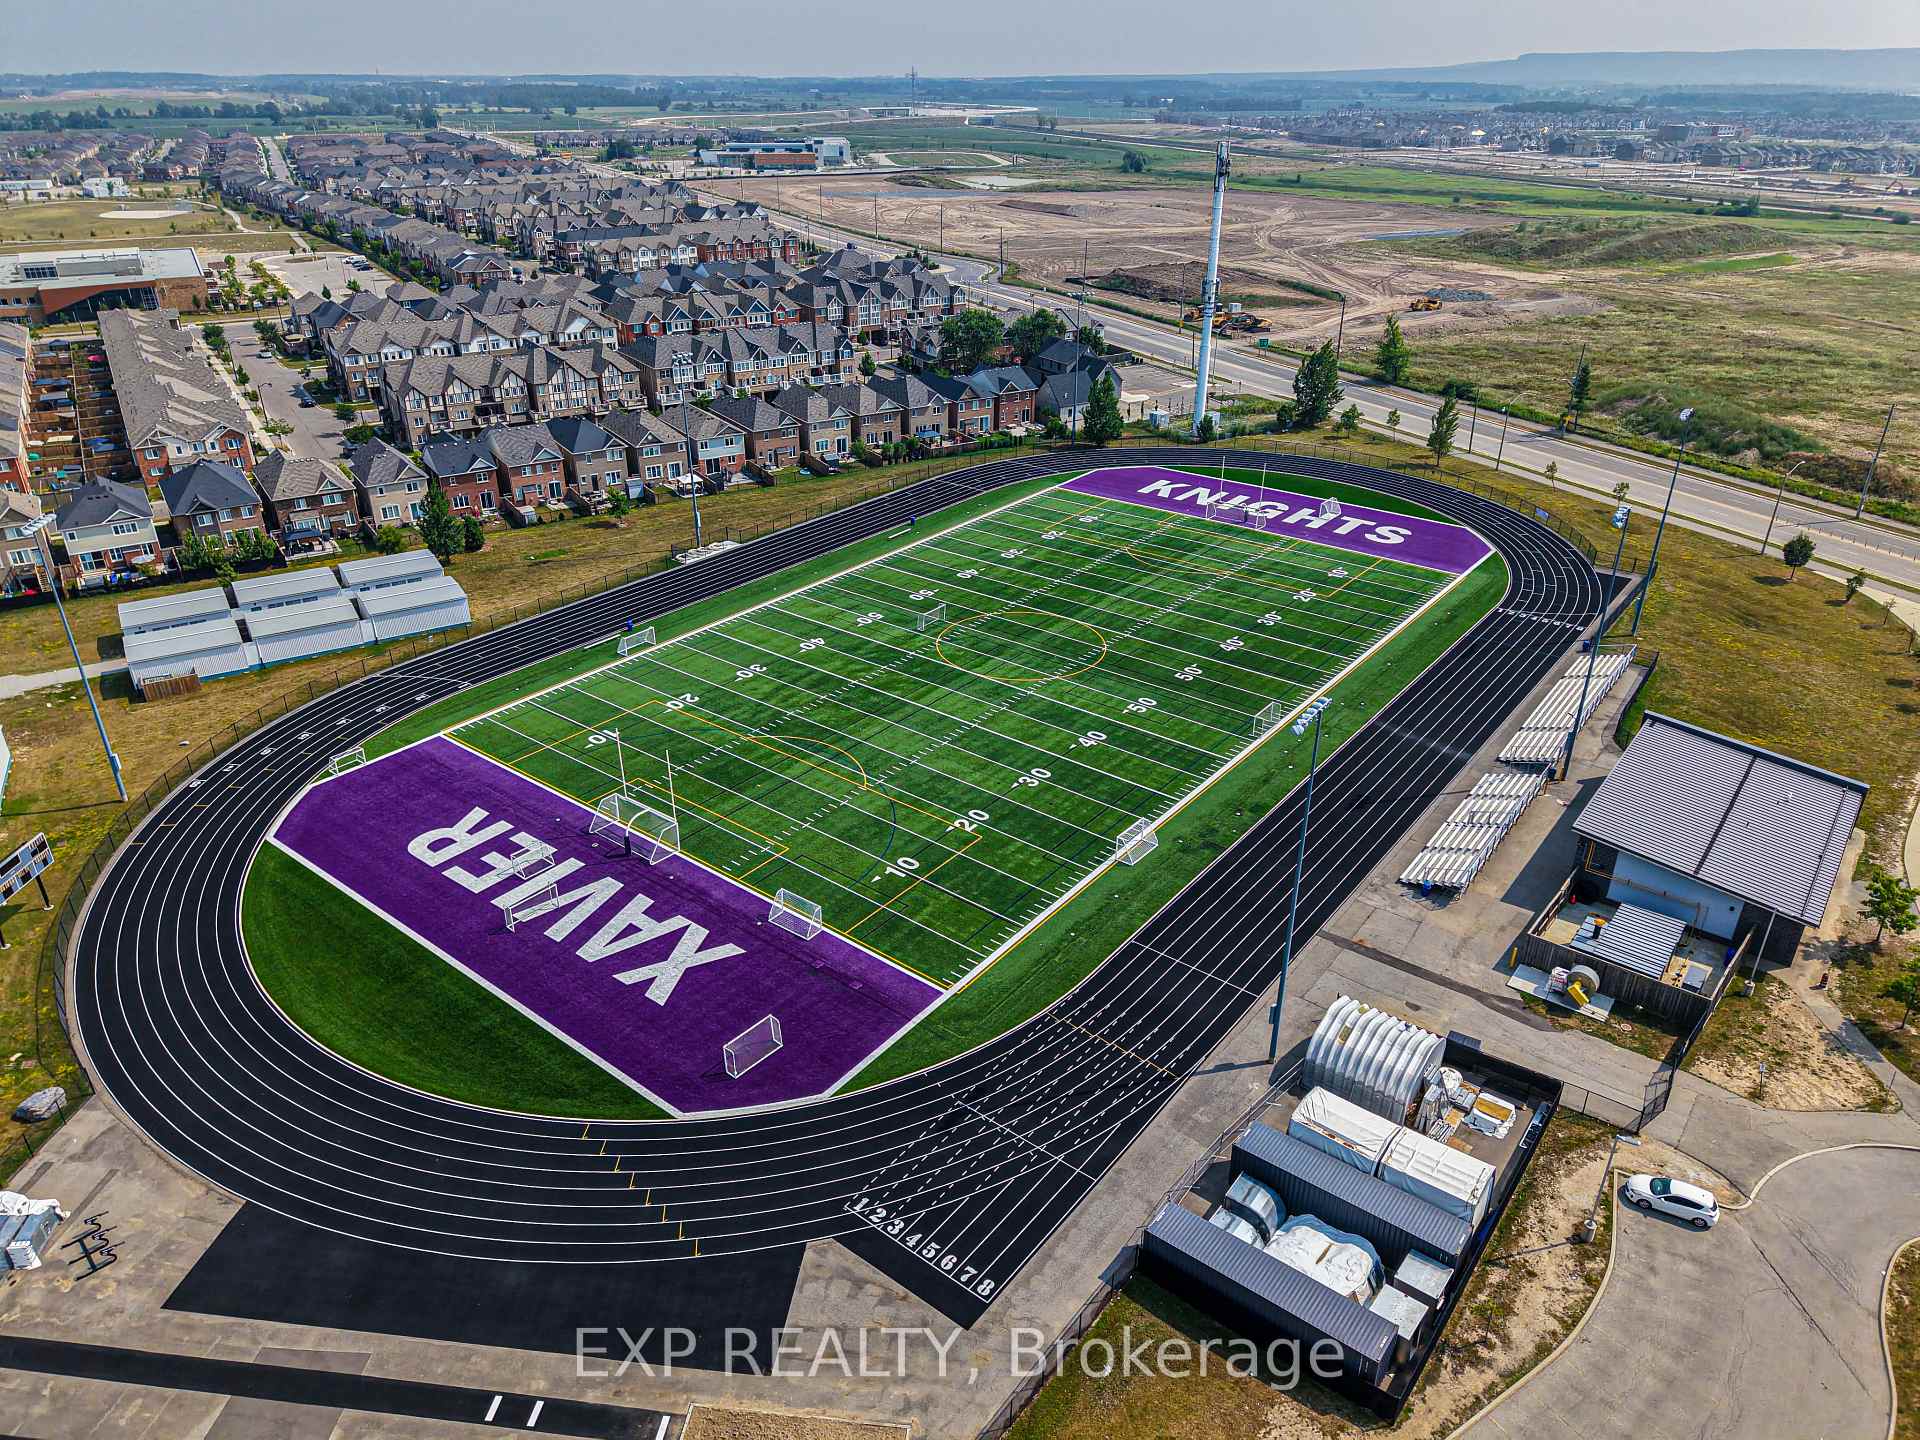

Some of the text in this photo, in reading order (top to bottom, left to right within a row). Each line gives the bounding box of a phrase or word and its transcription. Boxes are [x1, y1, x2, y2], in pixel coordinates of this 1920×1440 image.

[1137, 480, 1412, 544] KNIGHTS
[909, 589, 934, 600] 50
[1293, 590, 1316, 602] 20
[857, 612, 884, 624] 50
[1257, 613, 1282, 626] 30
[800, 638, 825, 650] 40
[1220, 637, 1244, 651] 40
[736, 664, 767, 678] 30
[1174, 667, 1203, 681] 50
[666, 693, 699, 710] 20
[1127, 697, 1157, 713] 50
[1078, 731, 1107, 747] 40
[1018, 768, 1052, 787] 30
[953, 810, 990, 832] 20
[885, 857, 920, 878] 10
[407, 806, 748, 1006] XAVIER
[853, 1197, 995, 1296] 1 2 3 4 5 6 7 8
